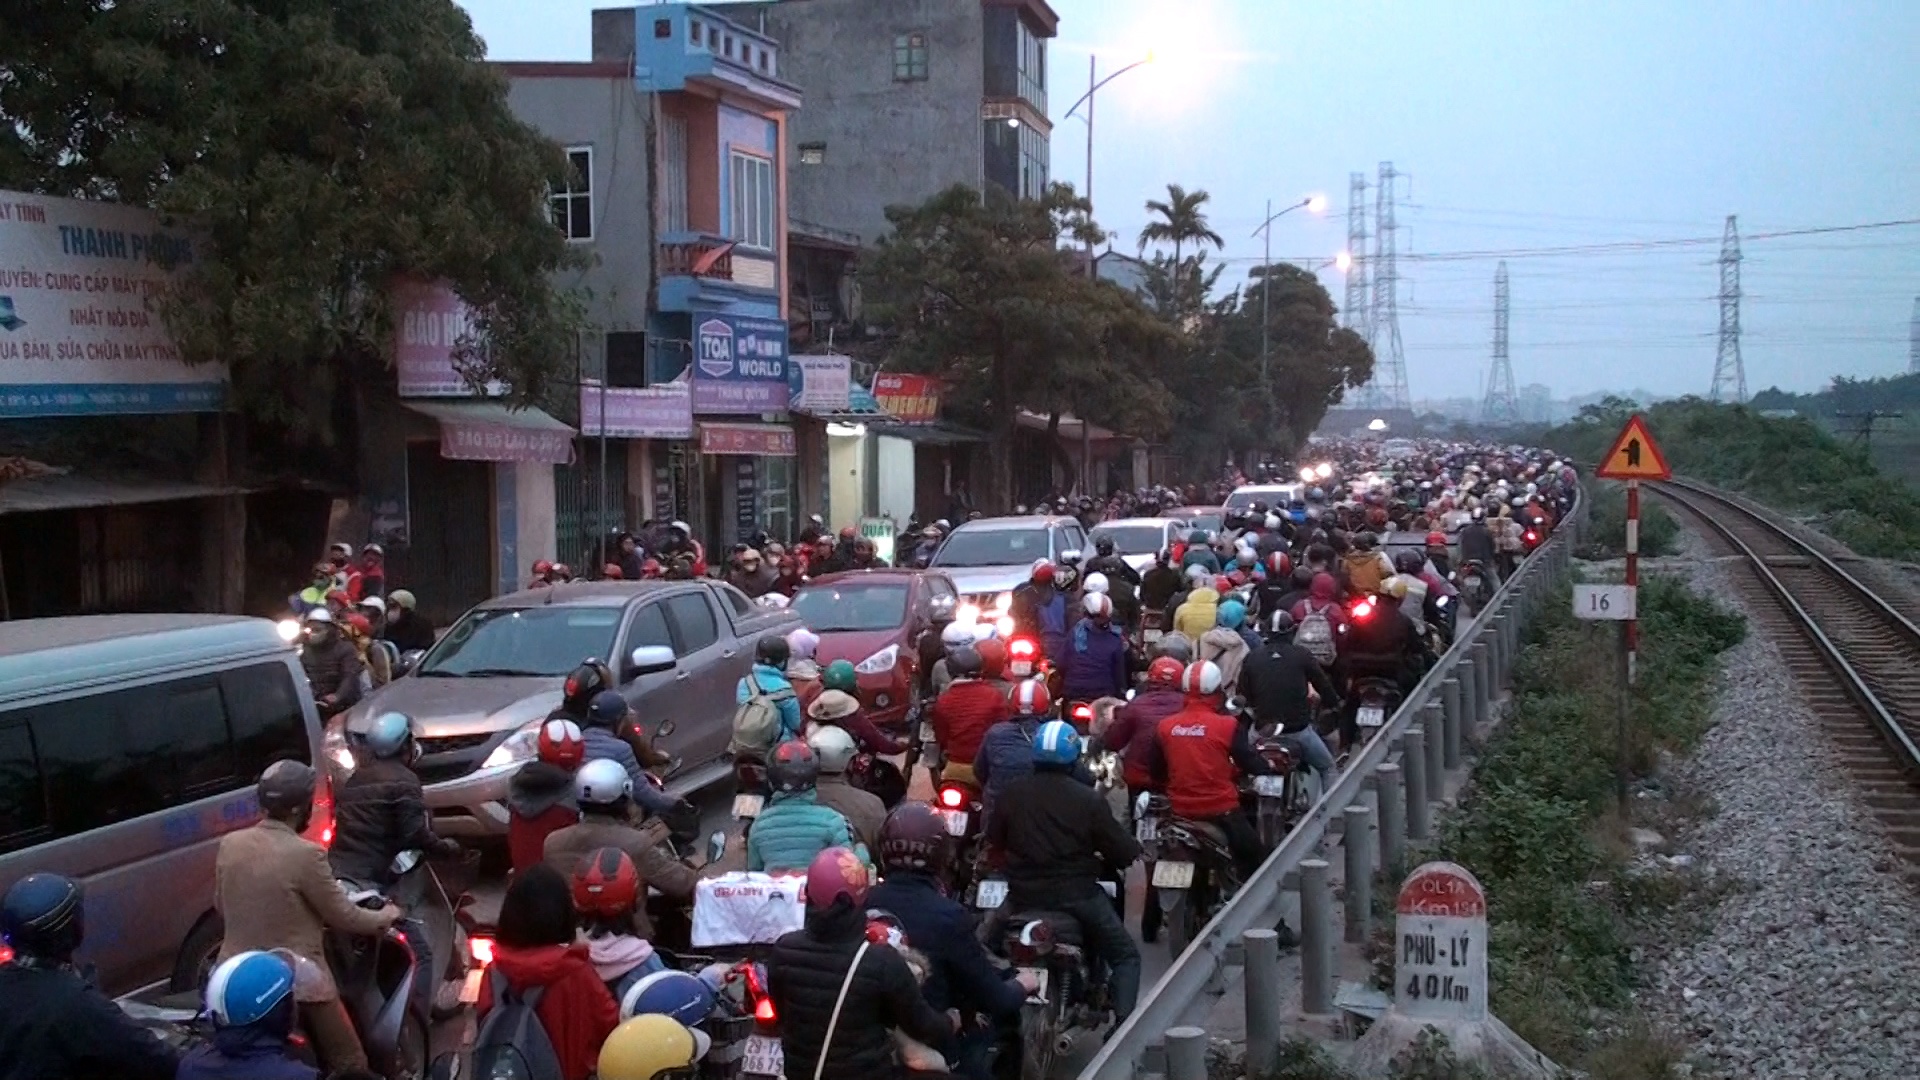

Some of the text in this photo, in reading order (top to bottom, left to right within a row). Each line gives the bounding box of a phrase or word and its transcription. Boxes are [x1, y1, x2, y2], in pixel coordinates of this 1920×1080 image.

[58, 225, 128, 260] THANH
[45, 271, 81, 291] CUNG
[702, 336, 730, 360] TOA
[738, 358, 782, 377] WORLD
[1592, 593, 1609, 612] 16
